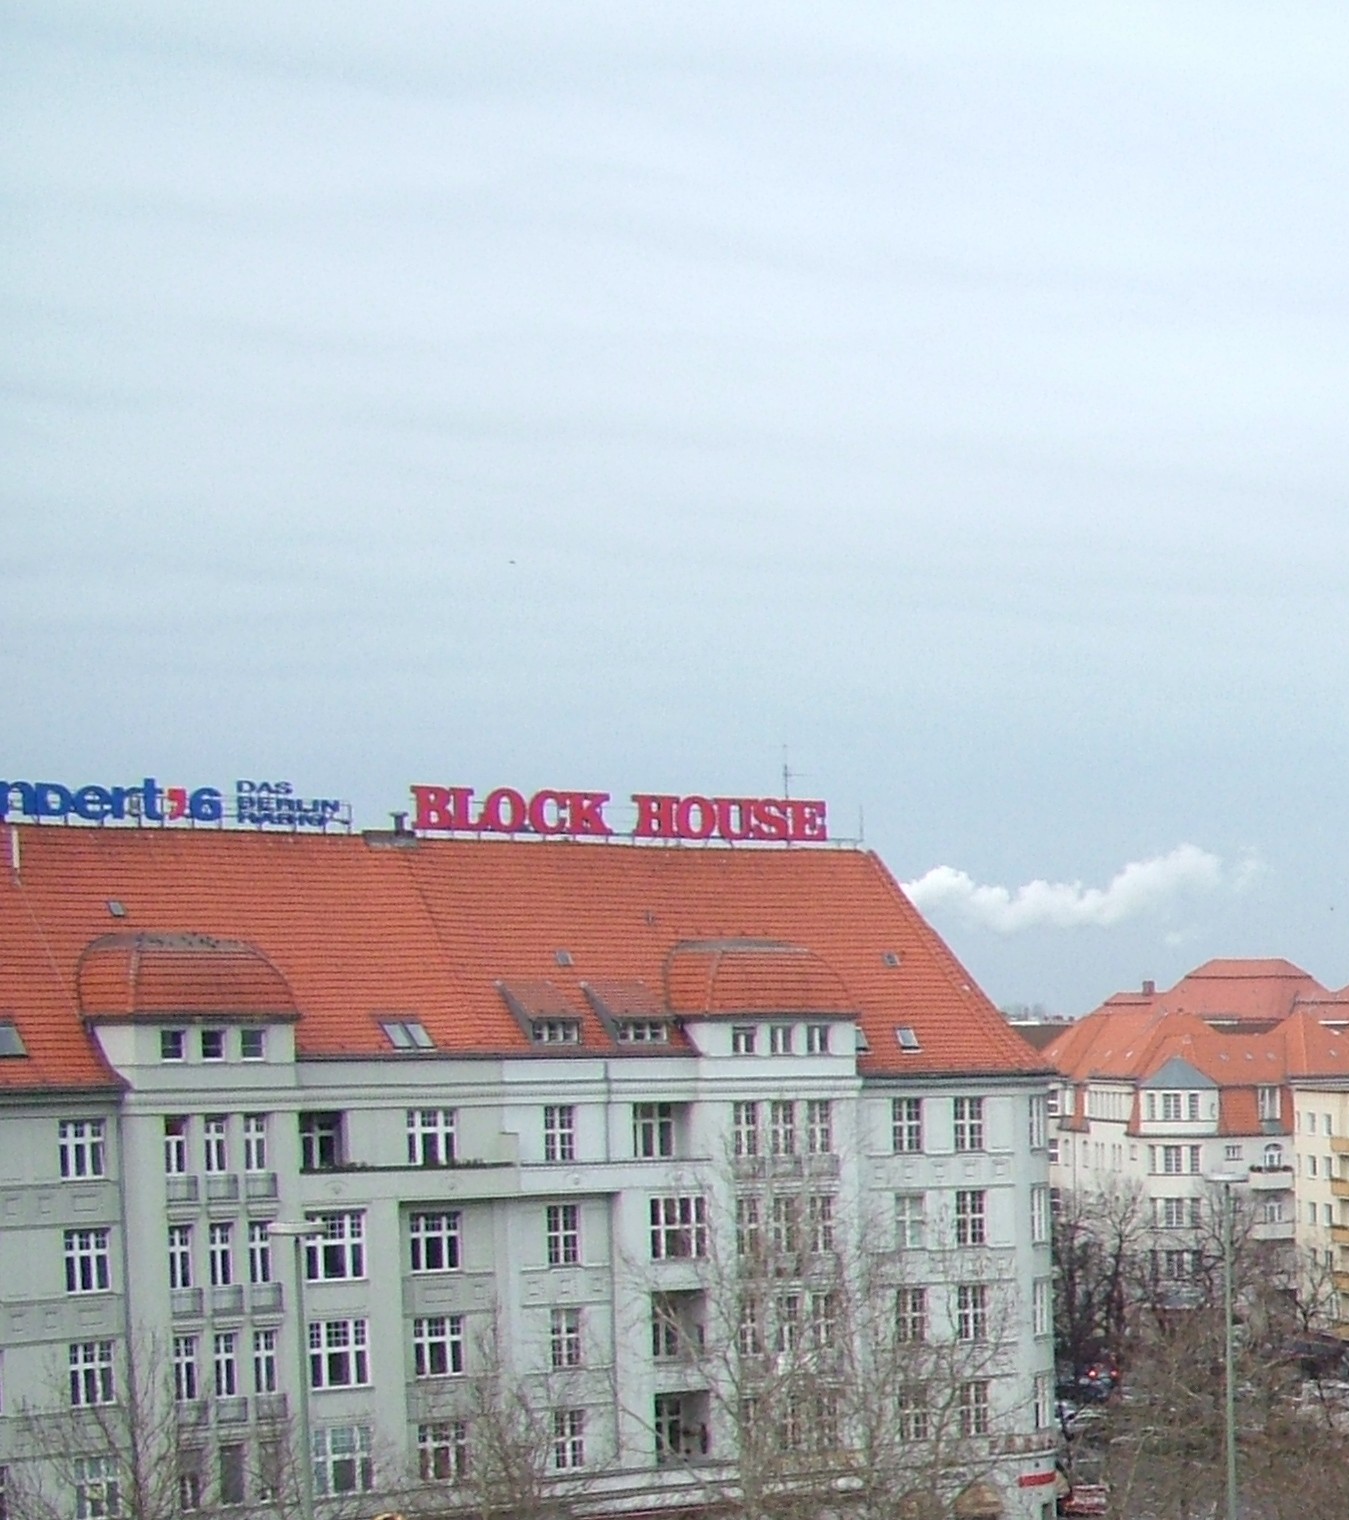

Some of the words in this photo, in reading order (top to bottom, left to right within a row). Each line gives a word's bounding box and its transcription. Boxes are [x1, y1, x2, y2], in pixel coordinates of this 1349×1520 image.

[236, 779, 293, 795] DAS
[410, 784, 612, 835] BLOCK
[631, 794, 828, 842] HOUSE
